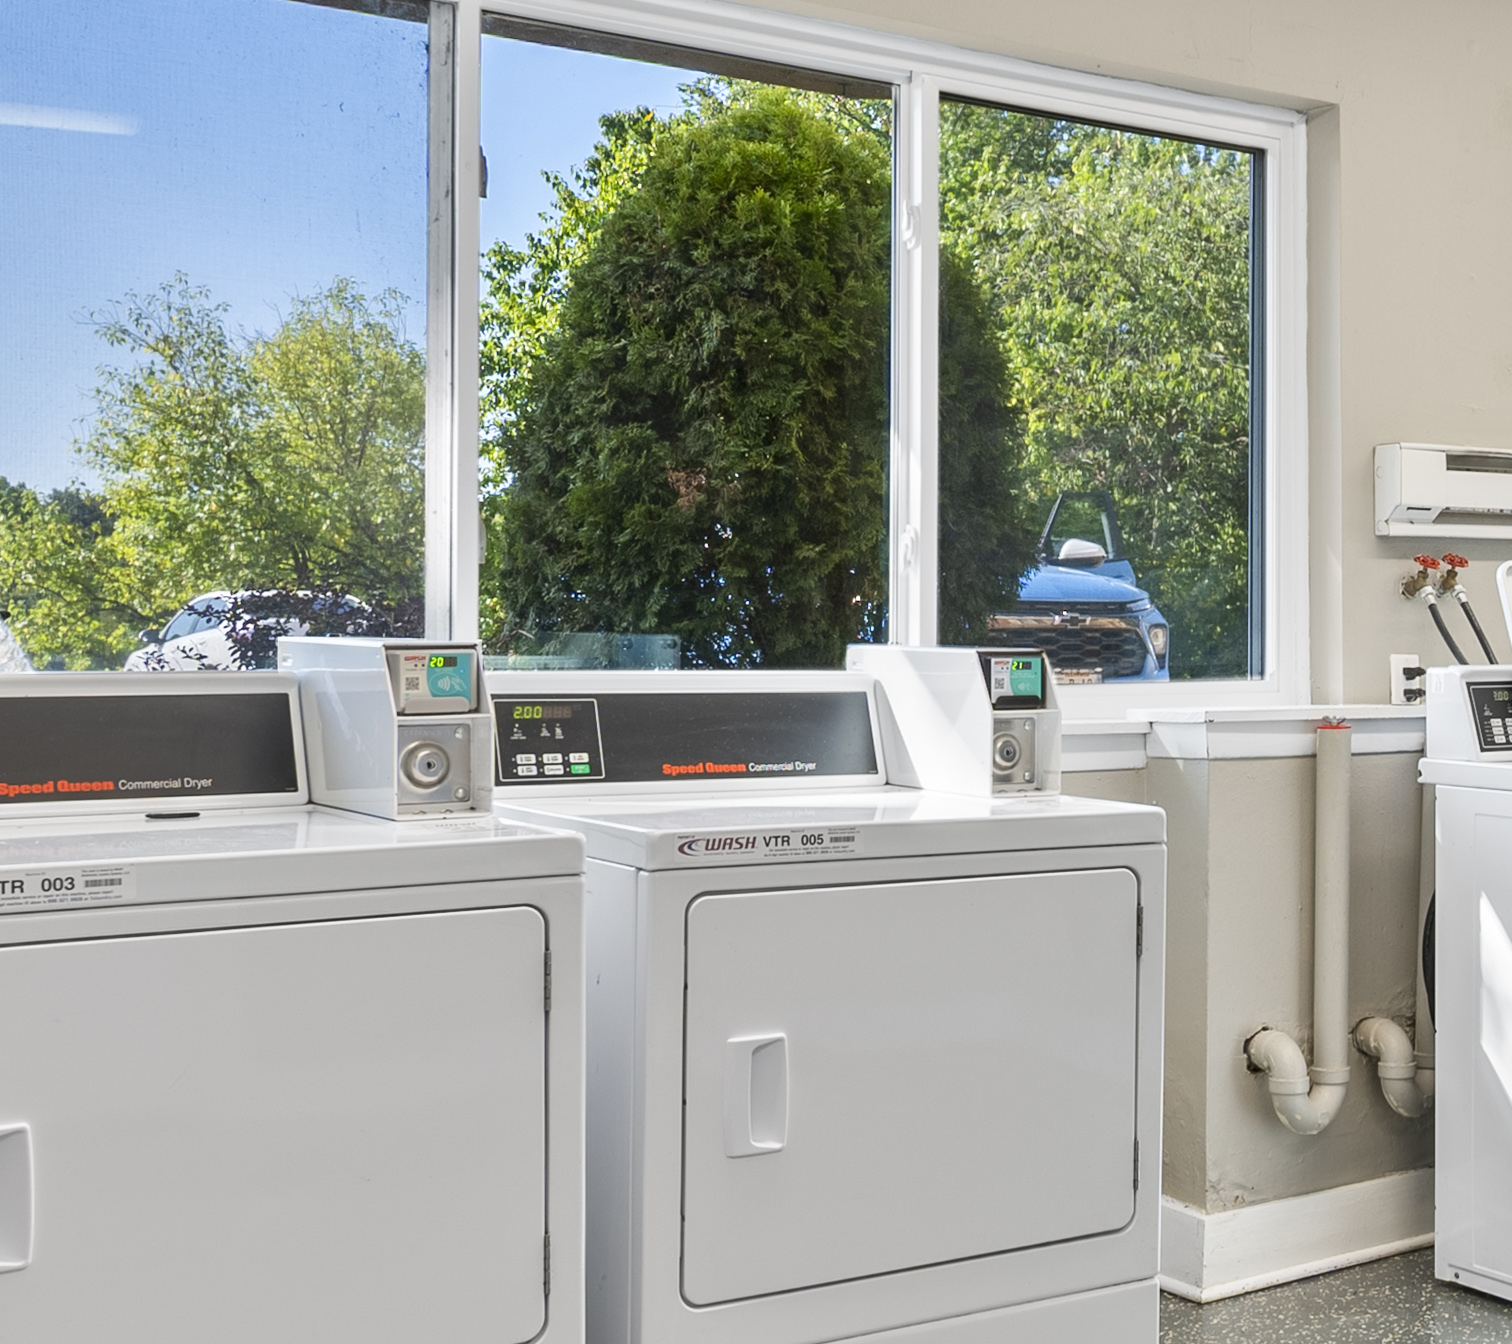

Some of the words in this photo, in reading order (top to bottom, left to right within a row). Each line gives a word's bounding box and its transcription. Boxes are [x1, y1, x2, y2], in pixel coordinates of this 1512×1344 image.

[430, 656, 444, 668] 20
[1012, 661, 1024, 671] 21
[514, 706, 542, 719] 2.00
[662, 762, 704, 776] Speed
[706, 762, 746, 773] Queen
[749, 761, 794, 773] Commercial
[795, 760, 816, 773] Dryer
[57, 780, 114, 792] Queen
[119, 778, 181, 790] Commercial
[184, 777, 212, 790] Dryer
[705, 836, 756, 851] WASH
[763, 836, 790, 847] VTR
[801, 834, 824, 846] 005
[41, 877, 75, 892] 003
